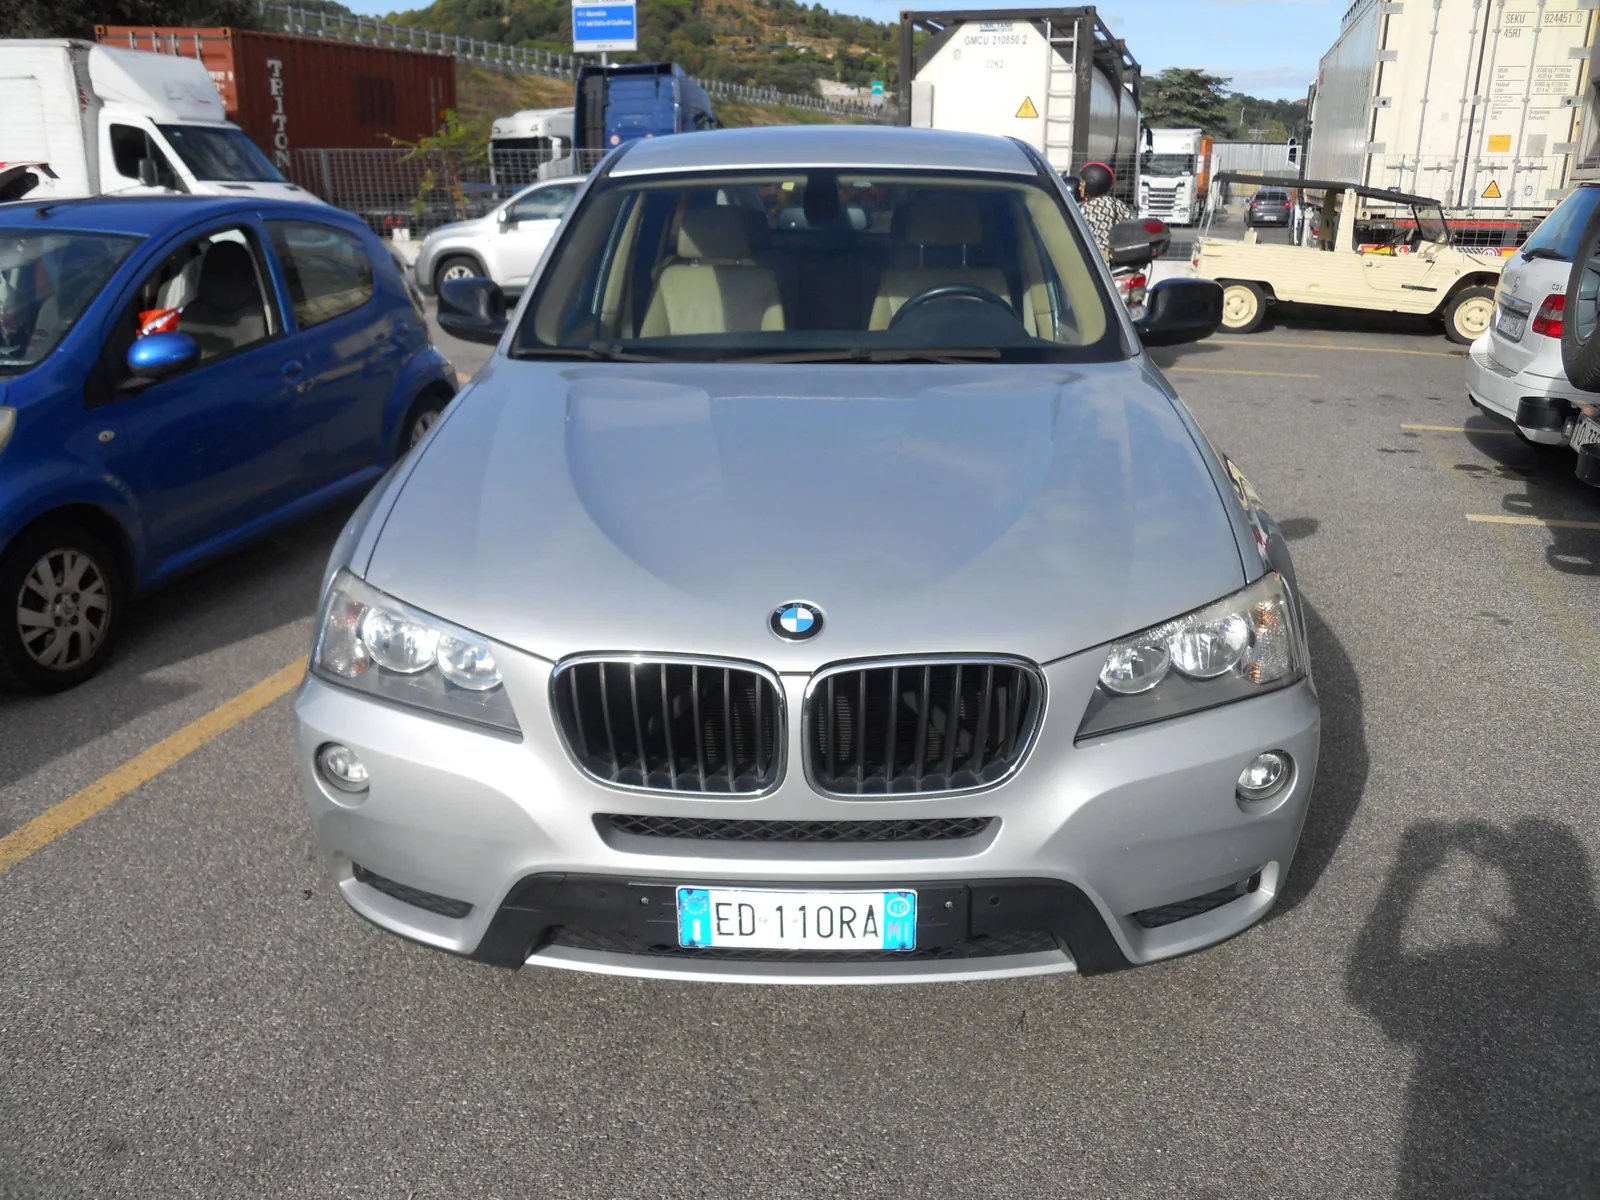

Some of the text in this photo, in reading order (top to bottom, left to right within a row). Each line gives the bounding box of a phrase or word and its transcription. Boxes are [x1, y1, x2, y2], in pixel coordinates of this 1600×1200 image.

[1505, 13, 1525, 24] SEKU
[1544, 13, 1572, 23] 924451
[1503, 28, 1521, 38] 45R1
[964, 35, 1028, 45] GMCU 210850 2
[266, 59, 291, 168] TRITON
[775, 603, 821, 614] BMW
[715, 902, 756, 937] ED
[887, 920, 910, 941] MI
